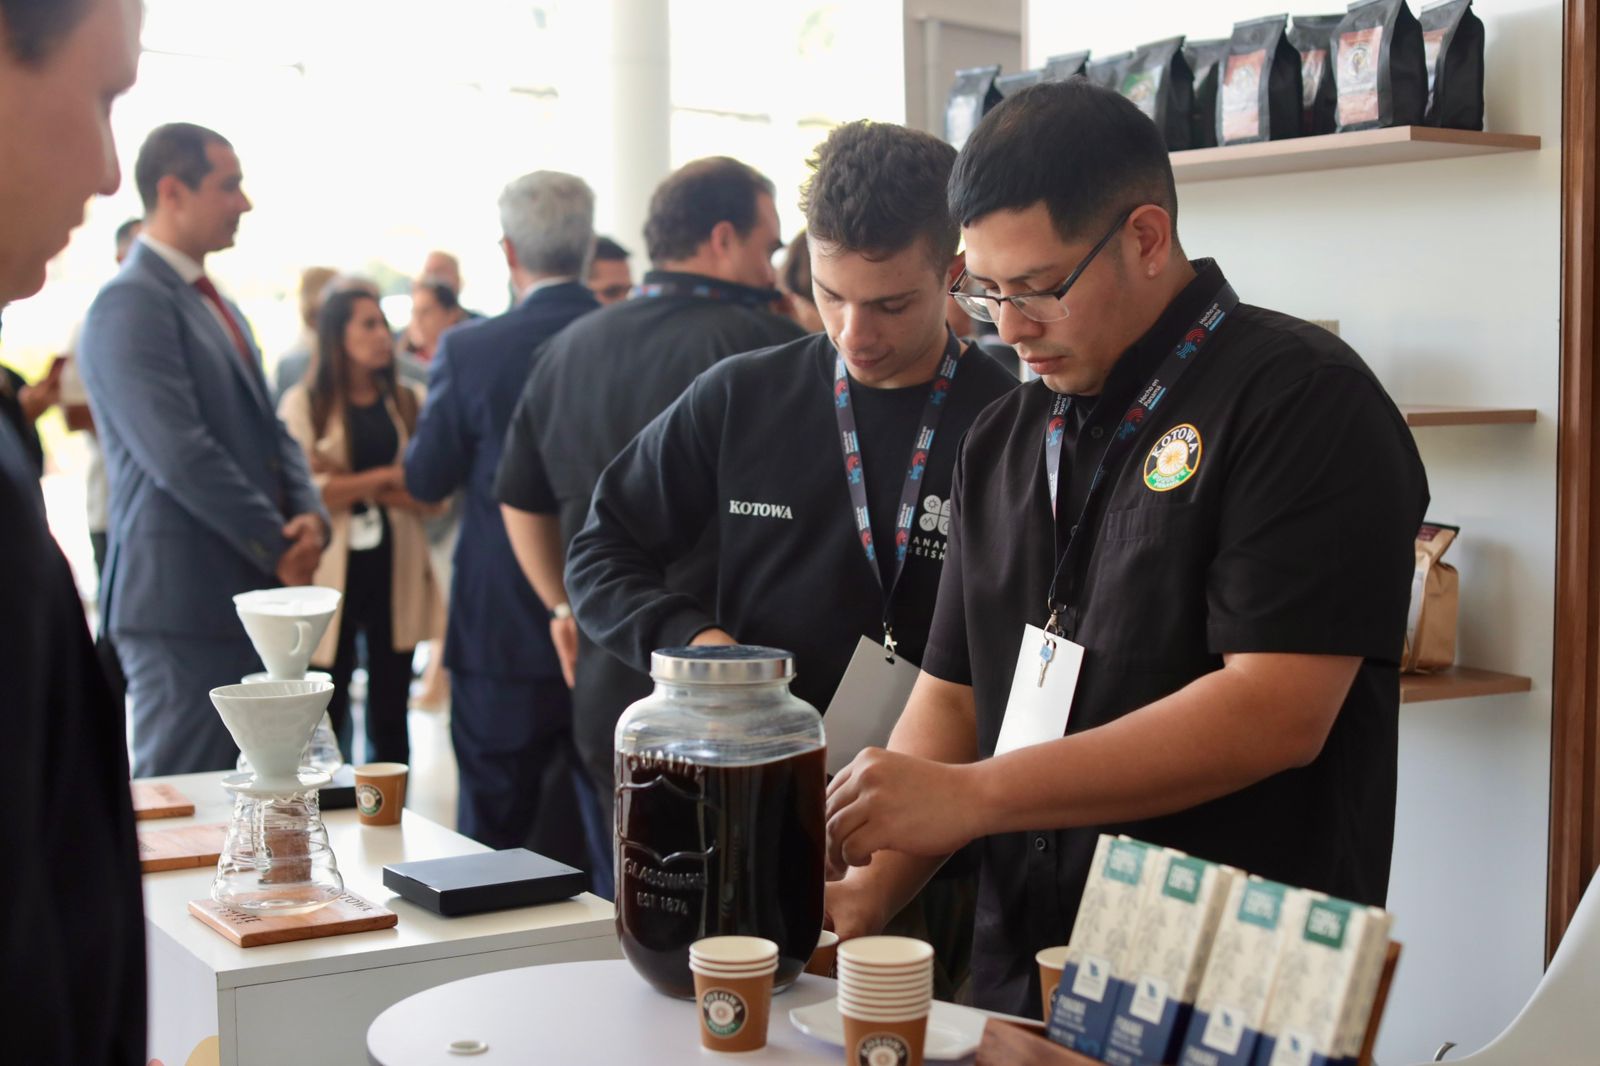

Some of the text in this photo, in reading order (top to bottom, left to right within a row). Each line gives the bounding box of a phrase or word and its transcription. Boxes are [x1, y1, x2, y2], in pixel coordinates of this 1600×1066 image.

[1151, 427, 1199, 458] KOTOWA
[729, 500, 793, 519] KOTOWA
[907, 546, 946, 560] EISH
